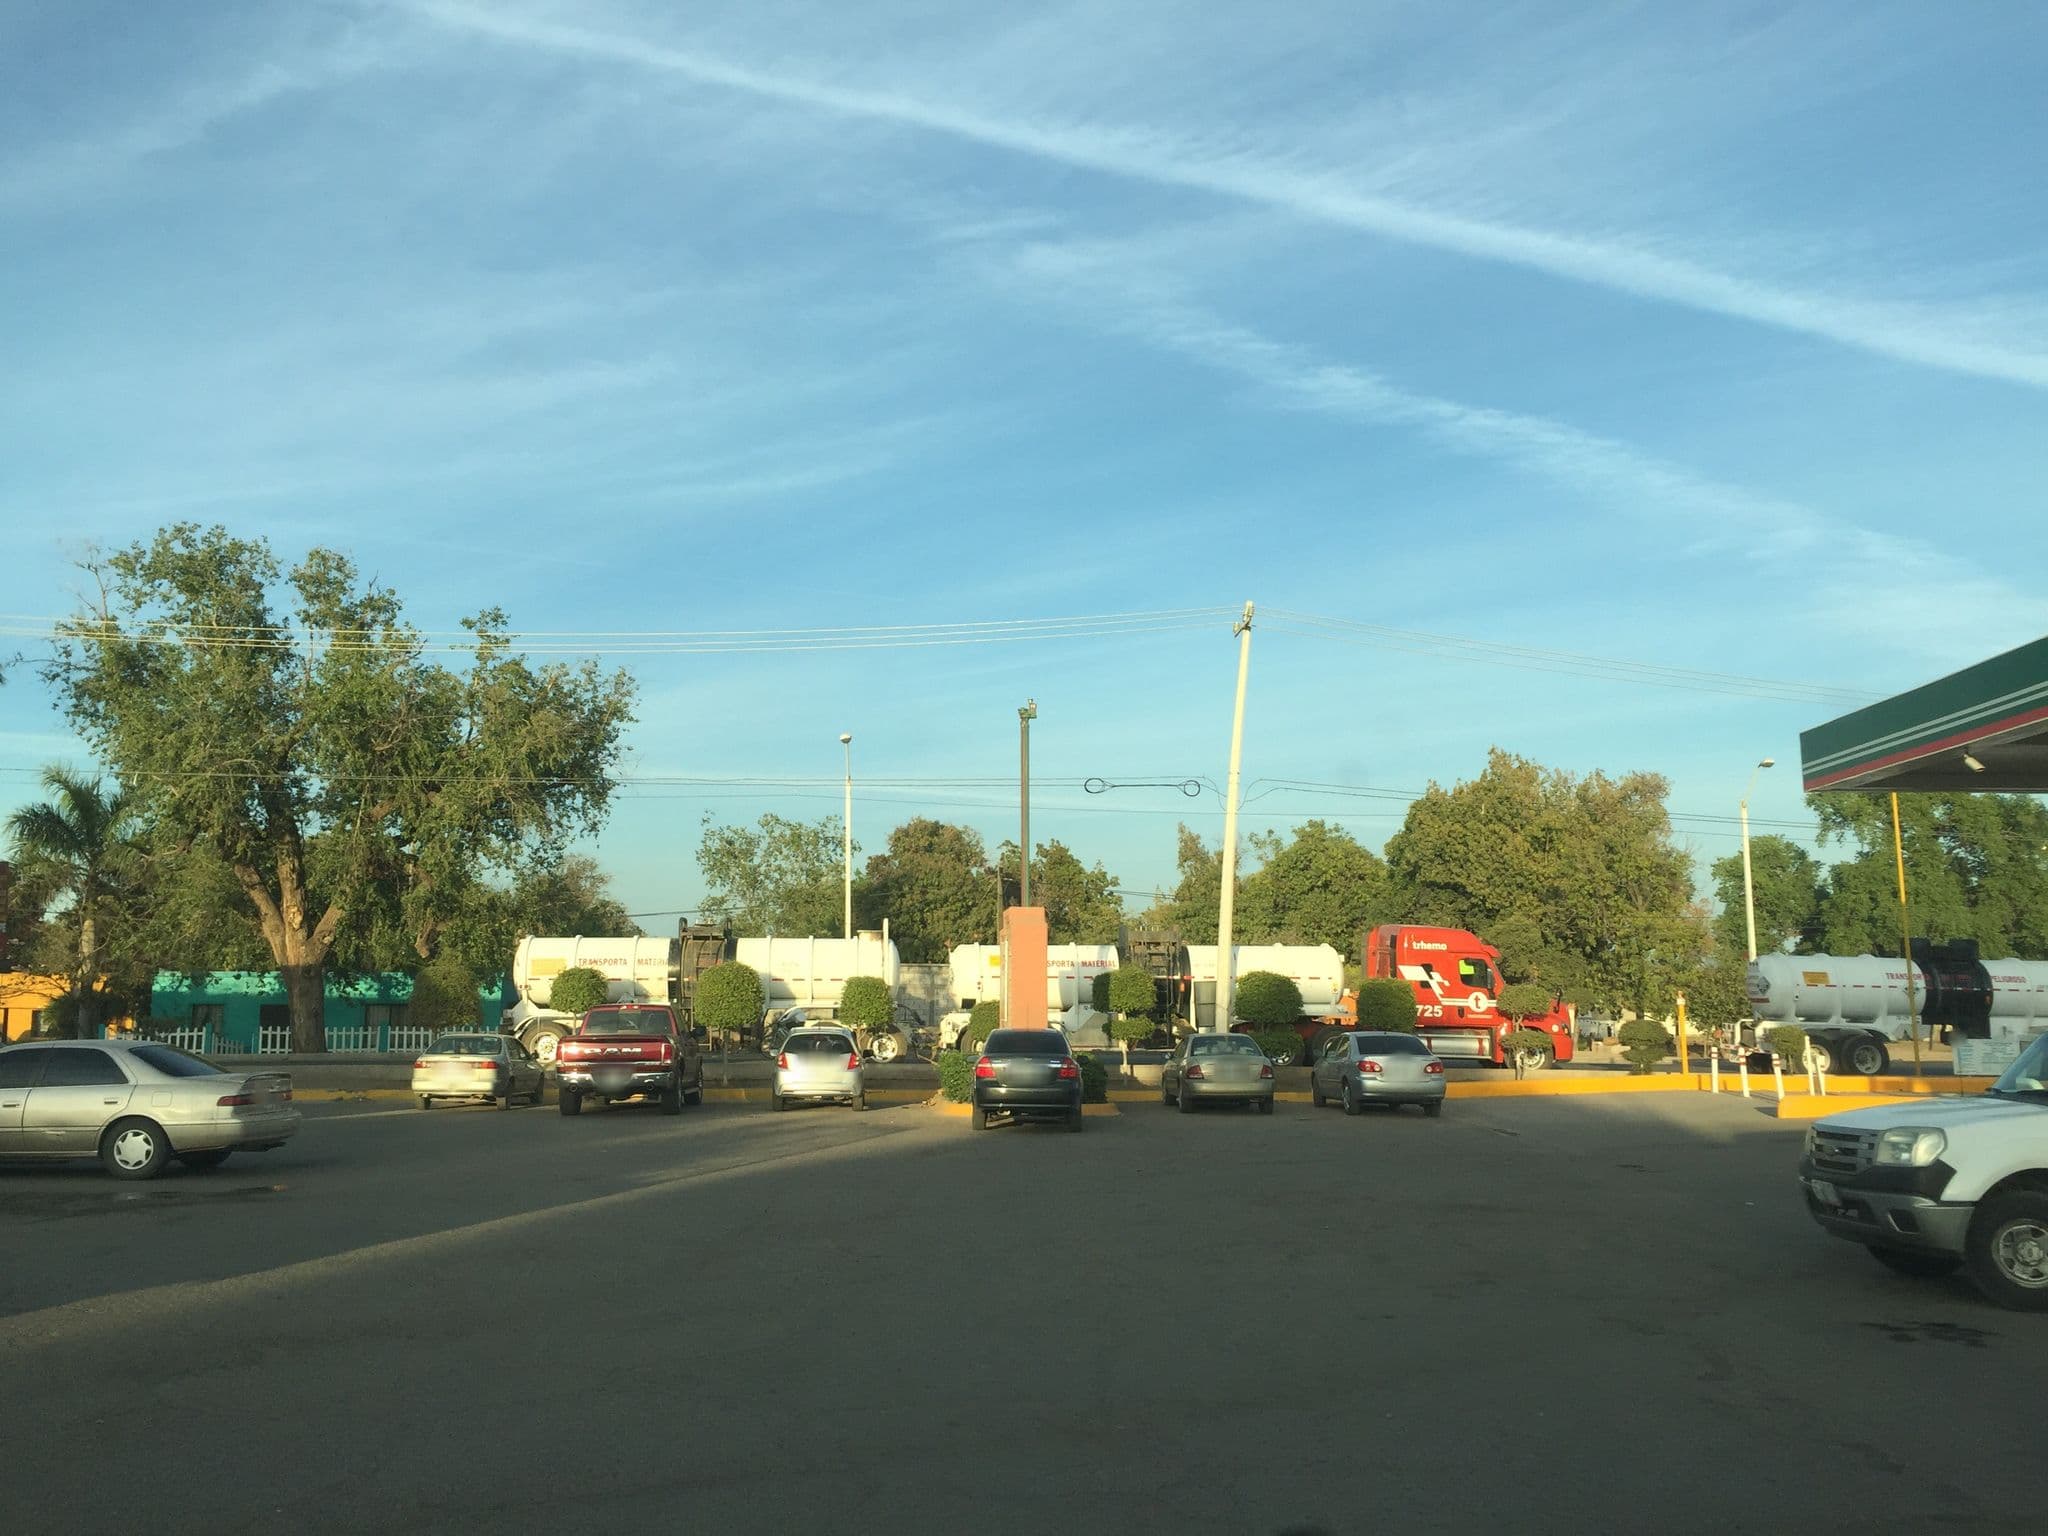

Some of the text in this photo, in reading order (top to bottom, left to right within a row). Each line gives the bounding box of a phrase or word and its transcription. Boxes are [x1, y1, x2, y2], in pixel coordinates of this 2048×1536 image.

[1412, 941, 1447, 951] trhemo
[578, 958, 627, 966] TRANSPORTA
[1047, 960, 1116, 968] SPORTA MATERIAL
[1416, 1004, 1443, 1018] 725
[584, 1047, 642, 1056] RAM
